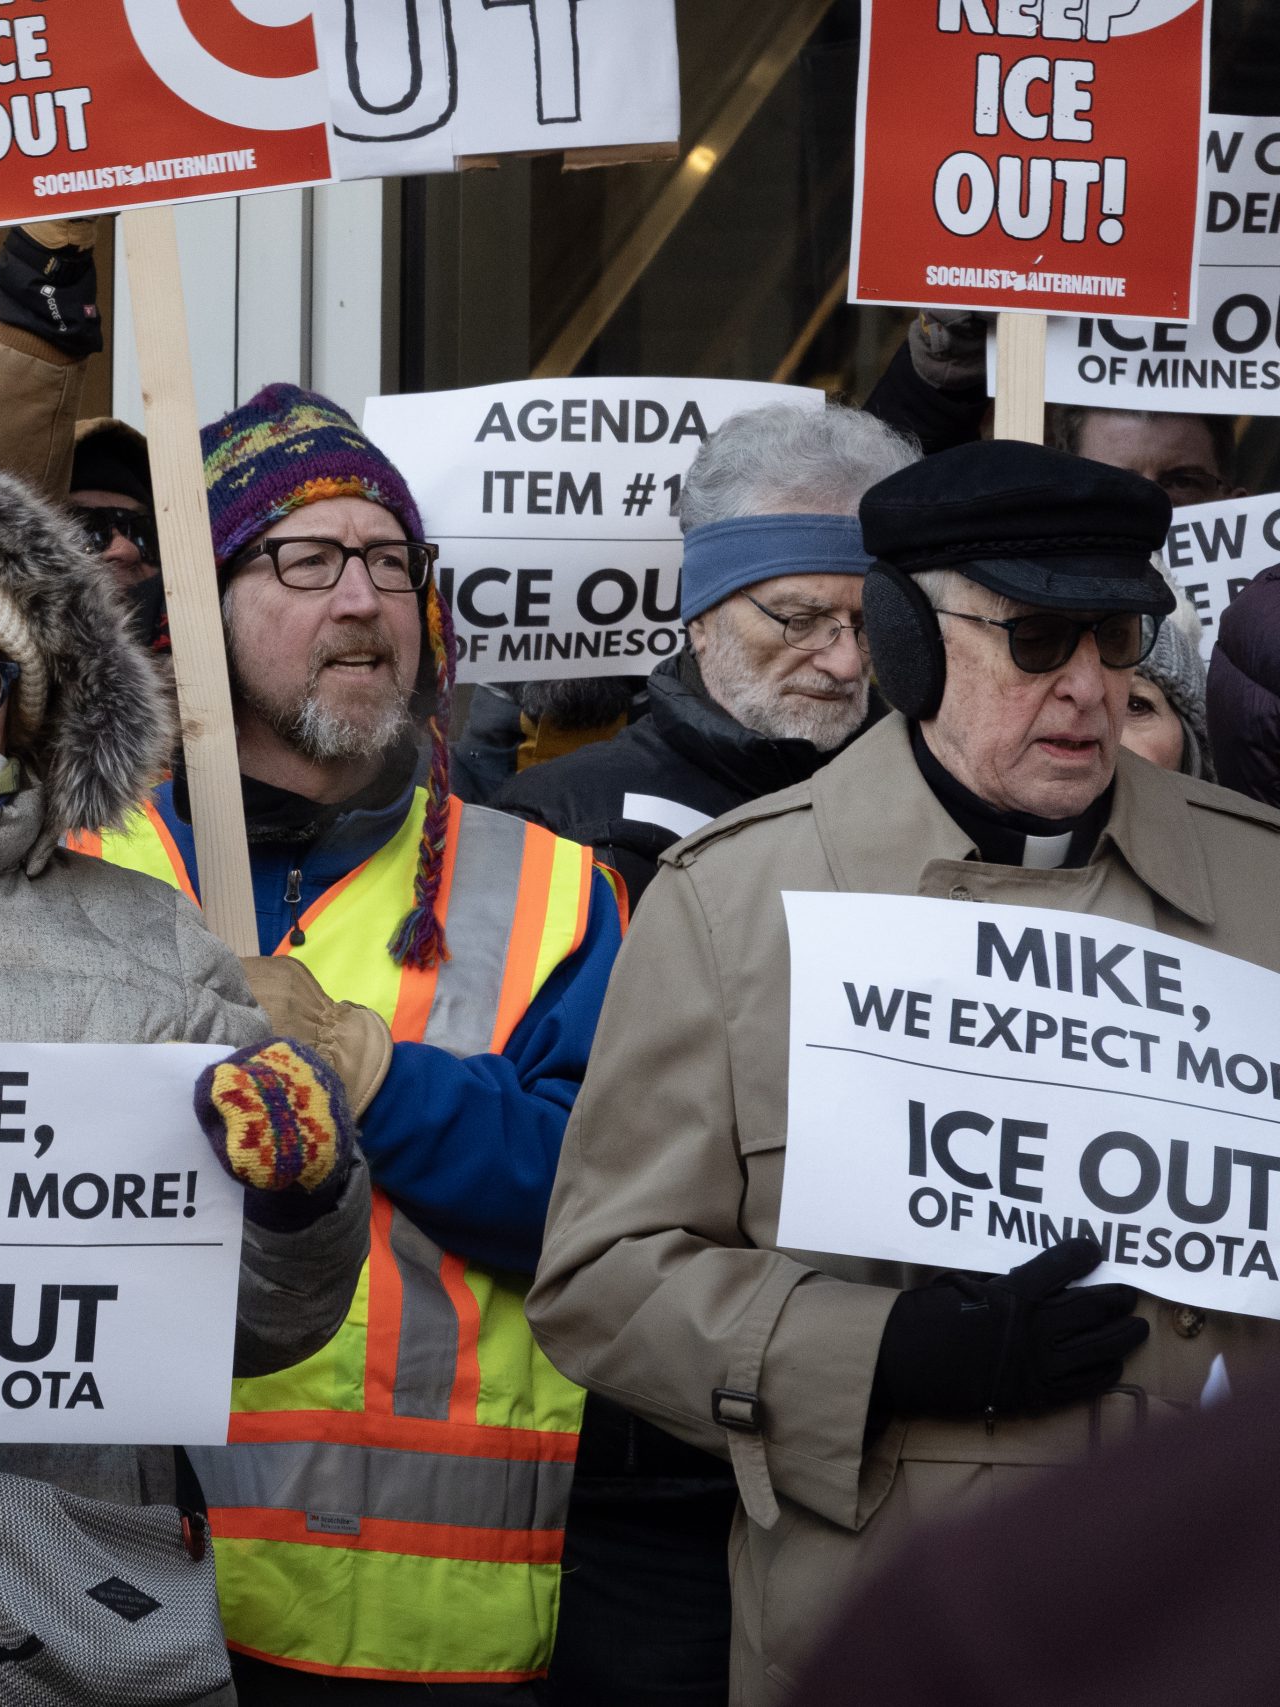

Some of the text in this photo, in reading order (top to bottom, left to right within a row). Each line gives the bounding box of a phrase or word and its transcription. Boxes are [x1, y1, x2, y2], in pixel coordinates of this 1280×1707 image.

[333, 0, 581, 142] UT
[973, 53, 1096, 143] ICE
[33, 148, 257, 197] SOCIALIST ALTERNATIVE
[932, 150, 1127, 245] OUT!
[926, 265, 1126, 297] SOCIALIST ALTERNATIVE
[1078, 355, 1128, 385] OF
[475, 399, 708, 444] AGENDA
[482, 471, 603, 516] ITEM
[1166, 514, 1247, 569] EW
[439, 567, 681, 629] ICE OU
[976, 920, 1212, 1033] MIKE,
[842, 981, 932, 1040] WE
[948, 997, 1161, 1074] EXPECT
[7, 1170, 198, 1219] MORE!
[907, 1099, 1280, 1232] ICE OUT
[908, 1186, 1280, 1282] OF MINNESOTA
